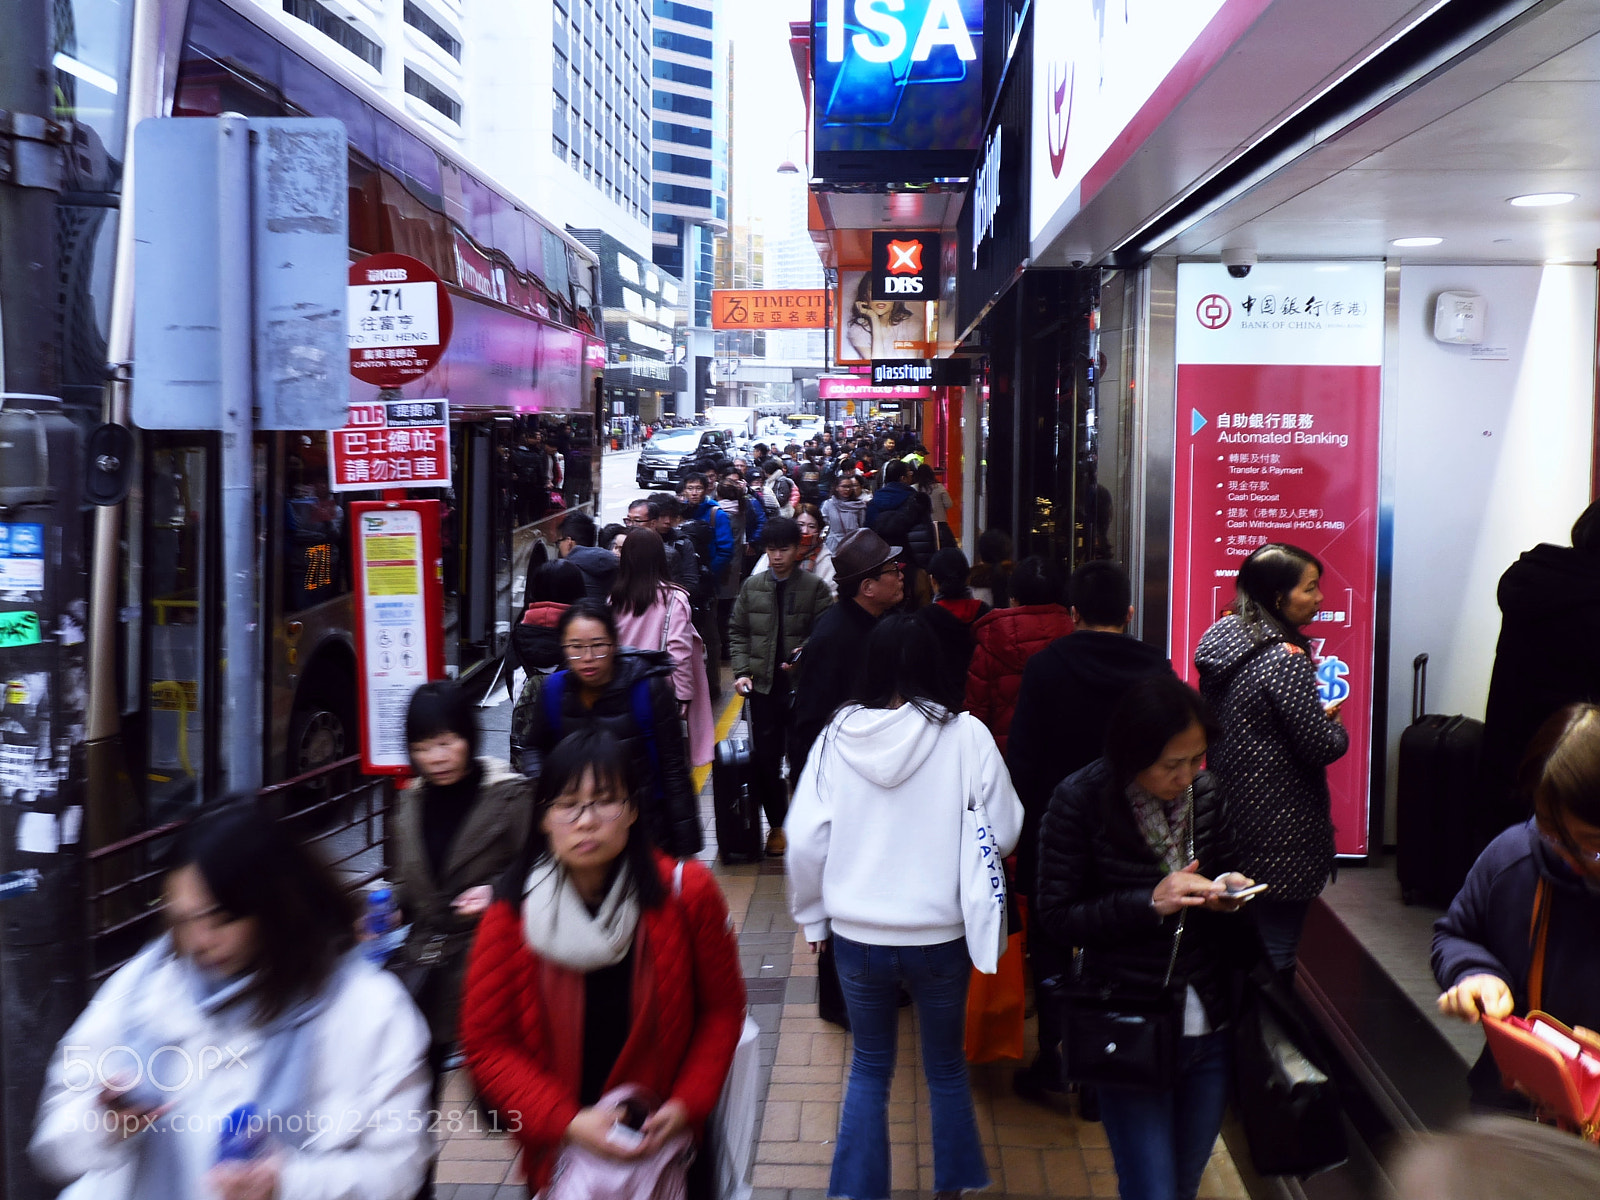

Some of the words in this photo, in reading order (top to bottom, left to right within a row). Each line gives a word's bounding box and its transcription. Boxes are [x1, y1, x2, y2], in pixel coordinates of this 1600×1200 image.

[884, 276, 924, 294] DBS
[369, 288, 402, 311] 271
[752, 295, 833, 308] TIMECIT
[1241, 321, 1269, 330] BANK
[1272, 321, 1285, 330] OF
[1288, 321, 1322, 330] CHINA
[395, 332, 428, 342] HENG
[388, 359, 413, 367] ROAD
[874, 364, 932, 382] glasstique
[1217, 412, 1314, 429] 自助銀行服務
[343, 429, 437, 455] 巴士總站
[1217, 431, 1291, 444] Automated
[1294, 431, 1349, 447] Banking
[344, 455, 438, 481] 請勿泊車
[1229, 466, 1260, 474] Transfer
[1261, 466, 1268, 474] &
[1269, 466, 1304, 476] Payment
[1228, 480, 1270, 491] 現金存款
[1228, 493, 1249, 501] Cash
[1250, 493, 1280, 503] Deposit
[1227, 520, 1247, 528] Cash
[1249, 520, 1292, 529] Withdrawal
[1293, 521, 1315, 529] (HKD
[1315, 521, 1322, 529] &
[1323, 521, 1345, 530] RMB)
